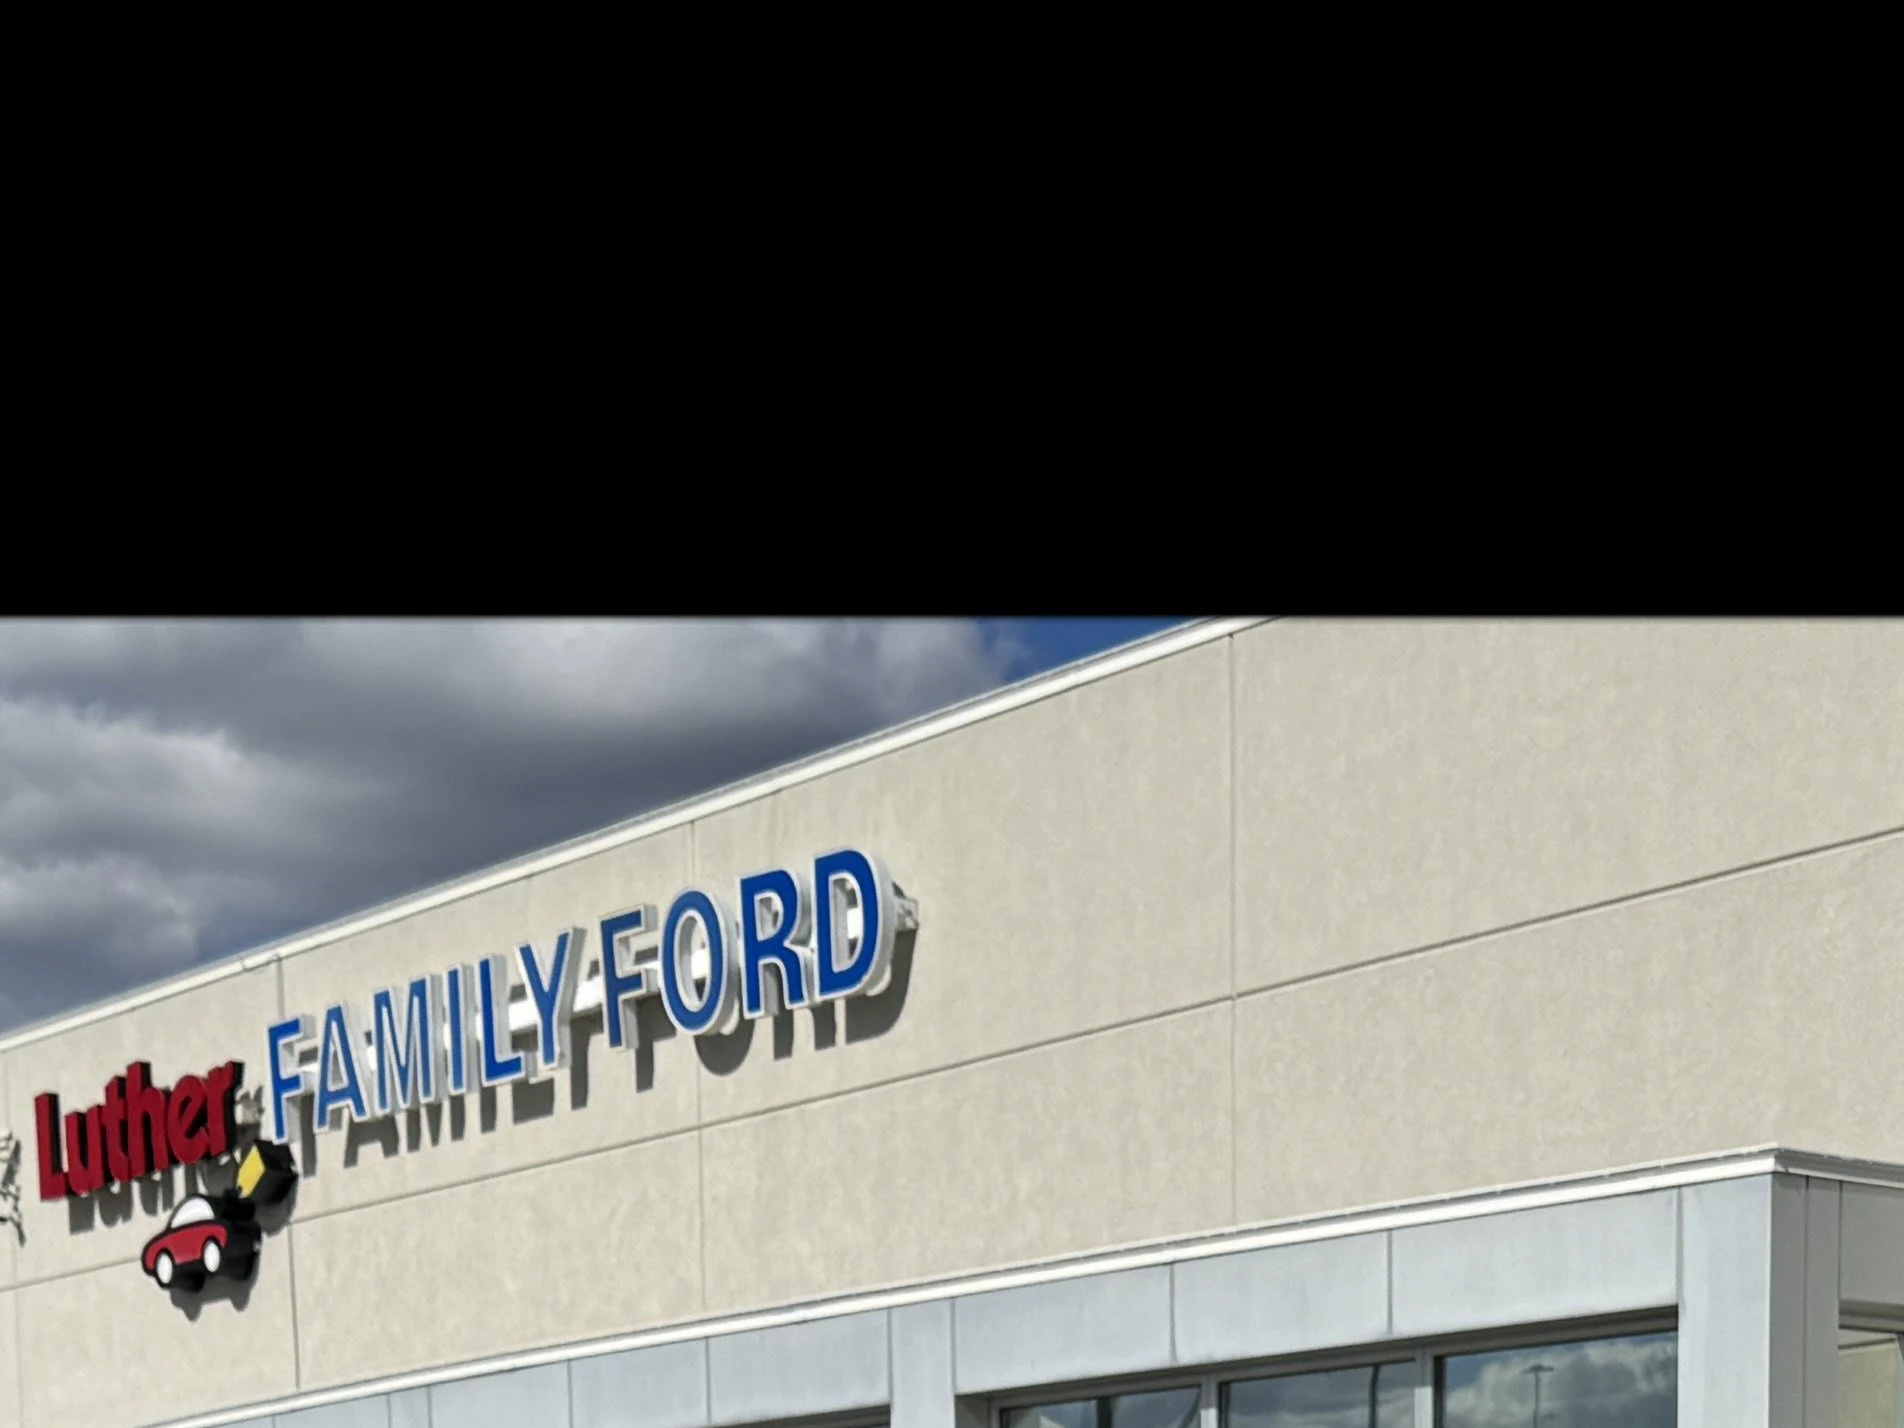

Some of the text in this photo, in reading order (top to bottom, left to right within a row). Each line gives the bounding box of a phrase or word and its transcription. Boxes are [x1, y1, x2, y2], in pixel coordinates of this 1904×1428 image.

[266, 848, 892, 1142] FAMILY FORD
[34, 1060, 244, 1200] Luther
